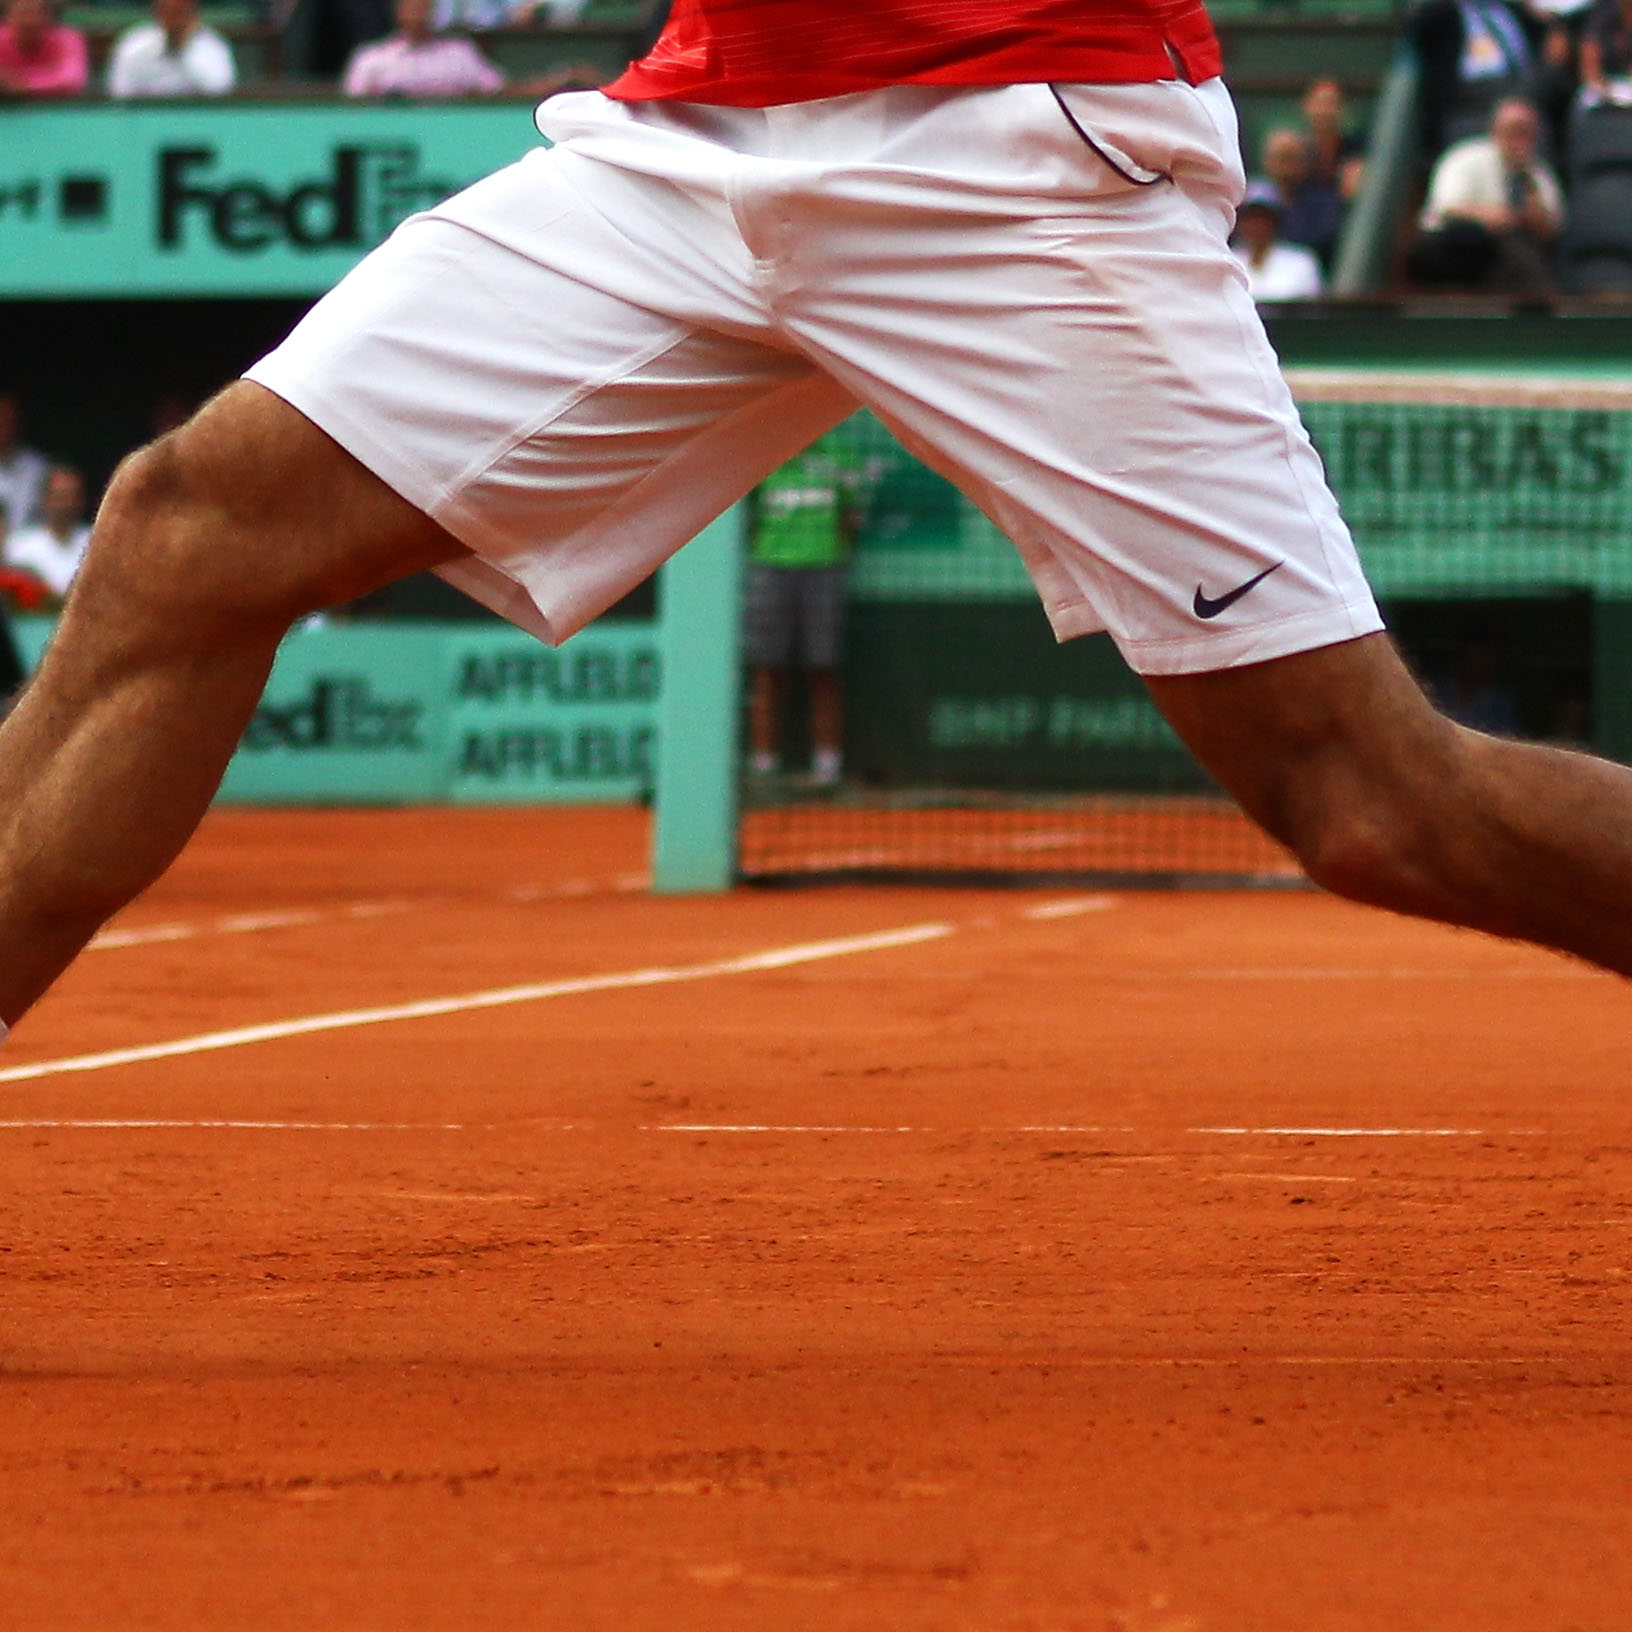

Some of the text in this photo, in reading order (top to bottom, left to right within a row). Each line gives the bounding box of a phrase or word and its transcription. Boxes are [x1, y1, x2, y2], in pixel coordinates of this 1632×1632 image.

[155, 140, 456, 255] FedE
[1340, 413, 1624, 494] RIBAS
[240, 674, 426, 752] edEx
